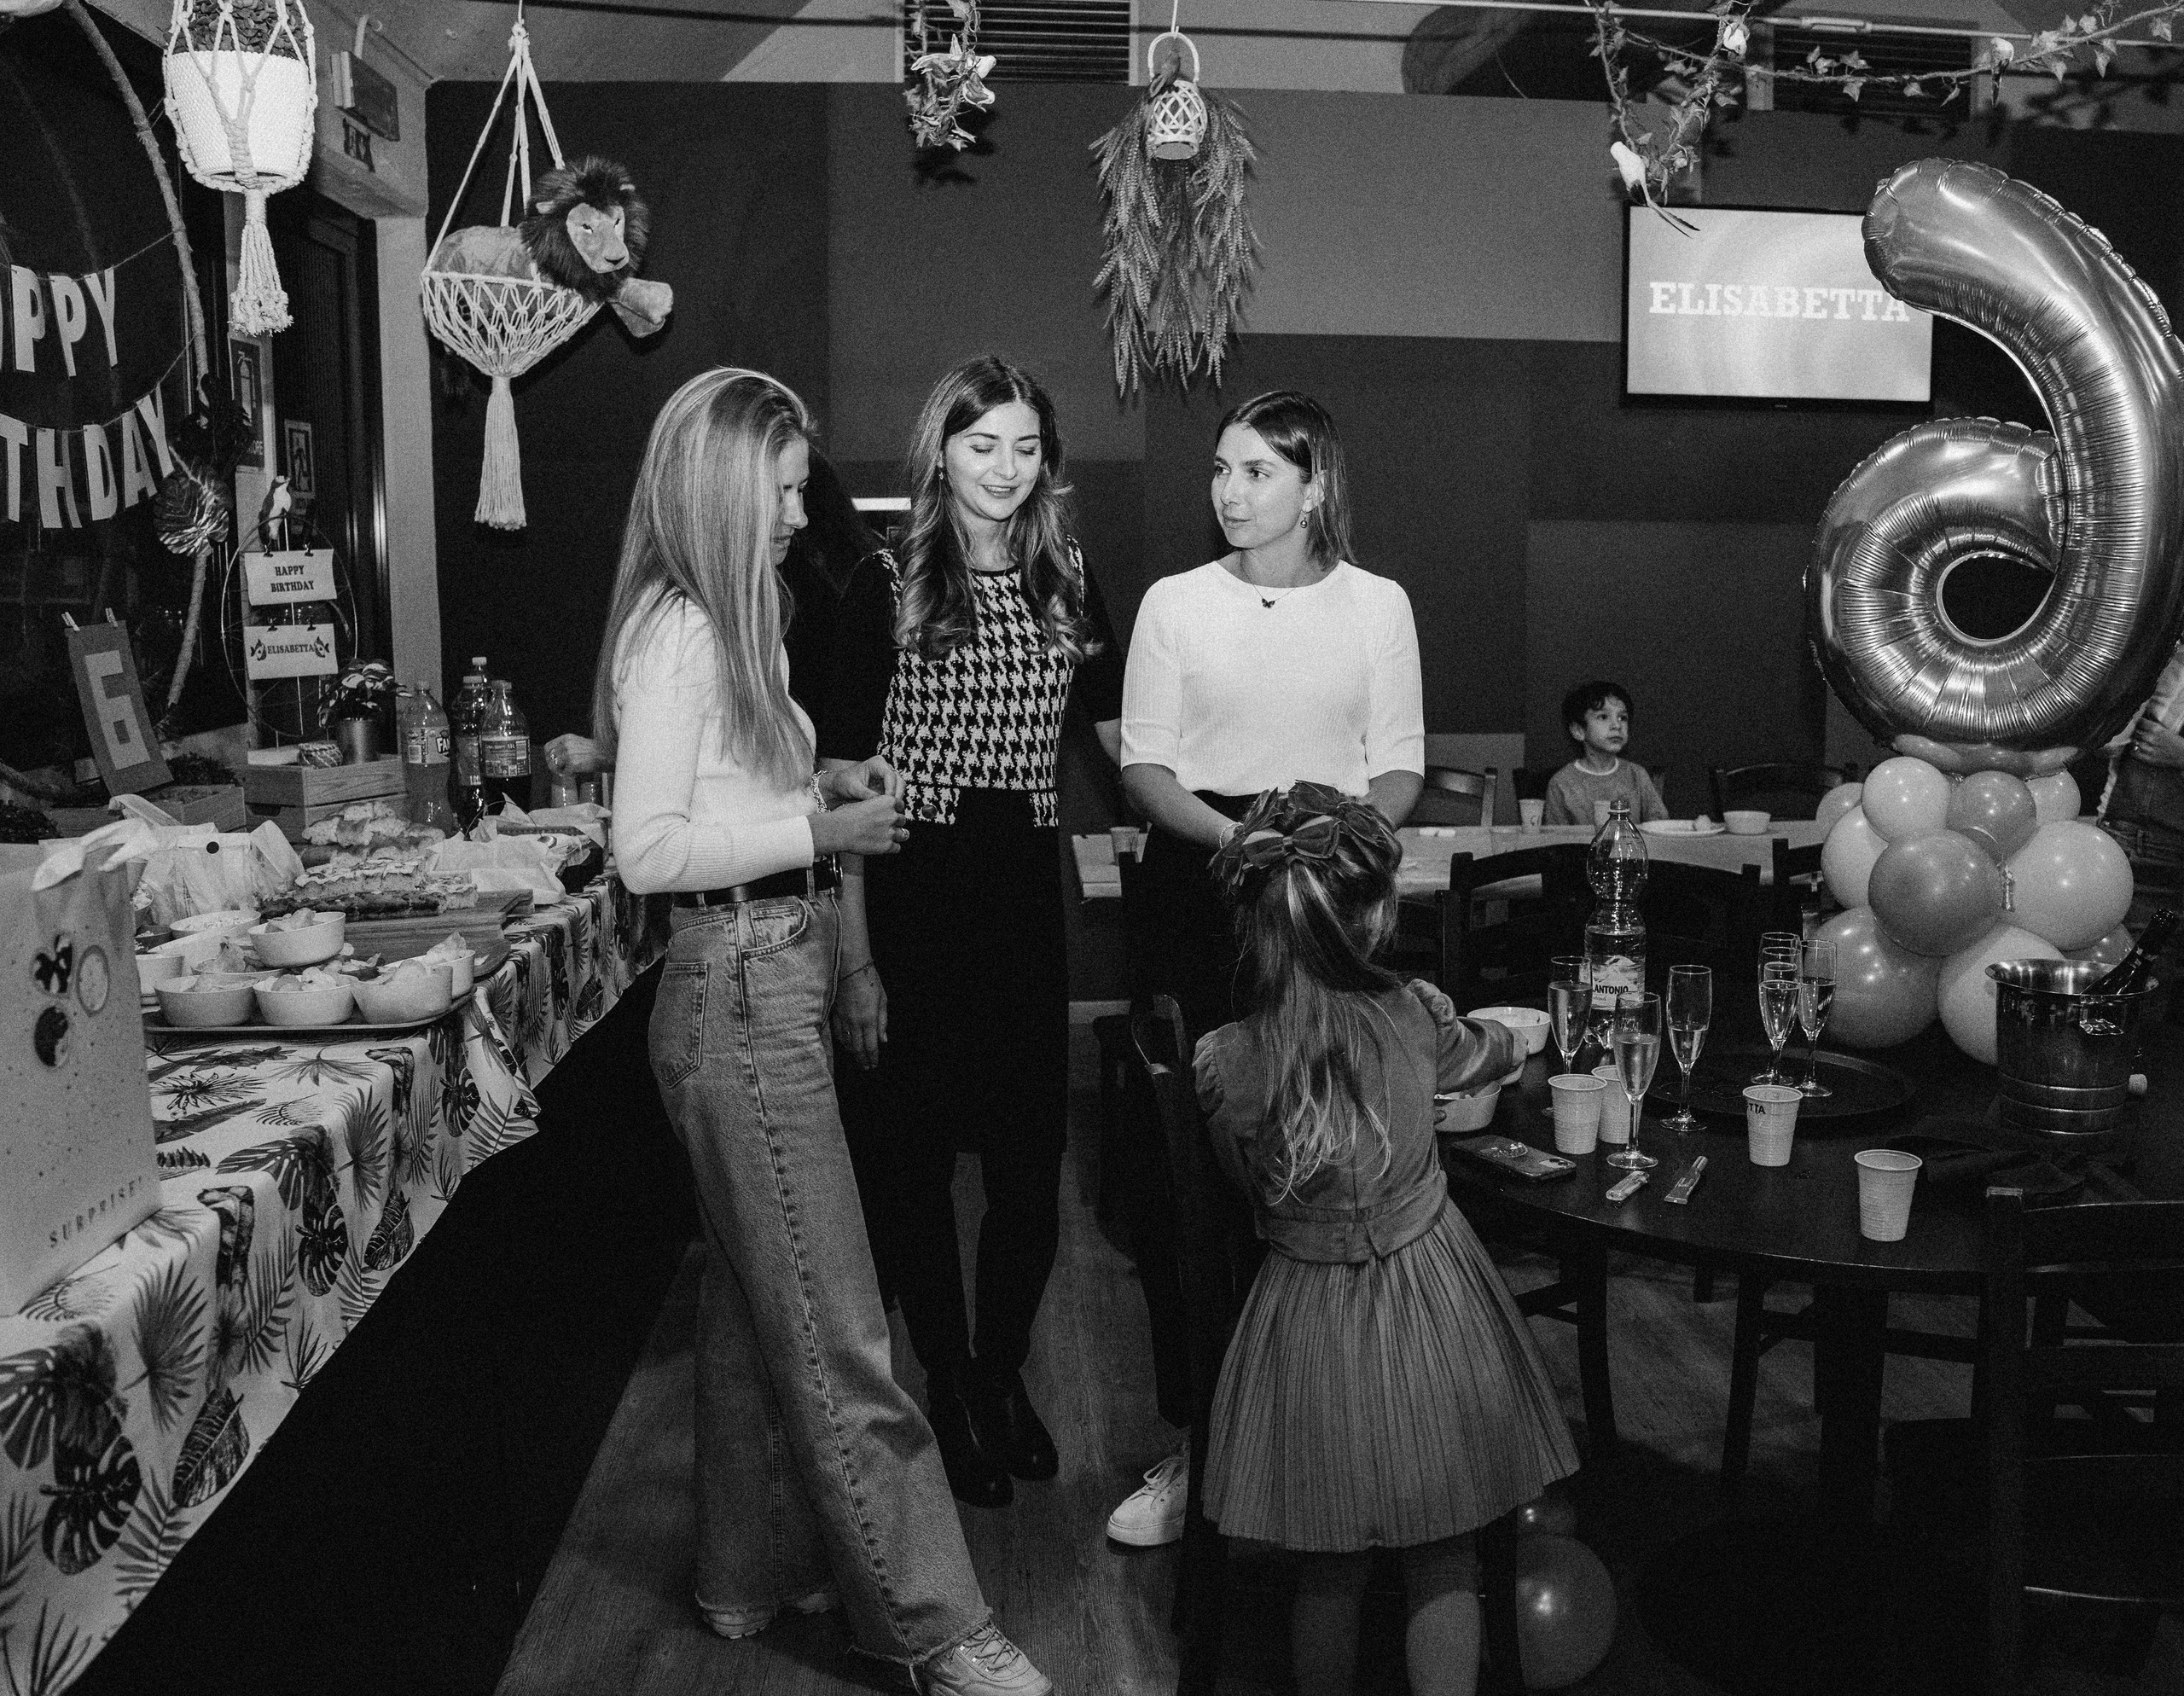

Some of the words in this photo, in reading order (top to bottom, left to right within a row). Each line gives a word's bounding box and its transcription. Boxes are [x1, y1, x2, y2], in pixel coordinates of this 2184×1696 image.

[1648, 281, 1910, 322] ELISABETTA
[0, 264, 118, 377] PPY
[275, 565, 305, 576] HAPPY
[270, 580, 315, 592] BIRTHDAY
[267, 643, 315, 654] ELISABETTA
[85, 649, 151, 771] 6
